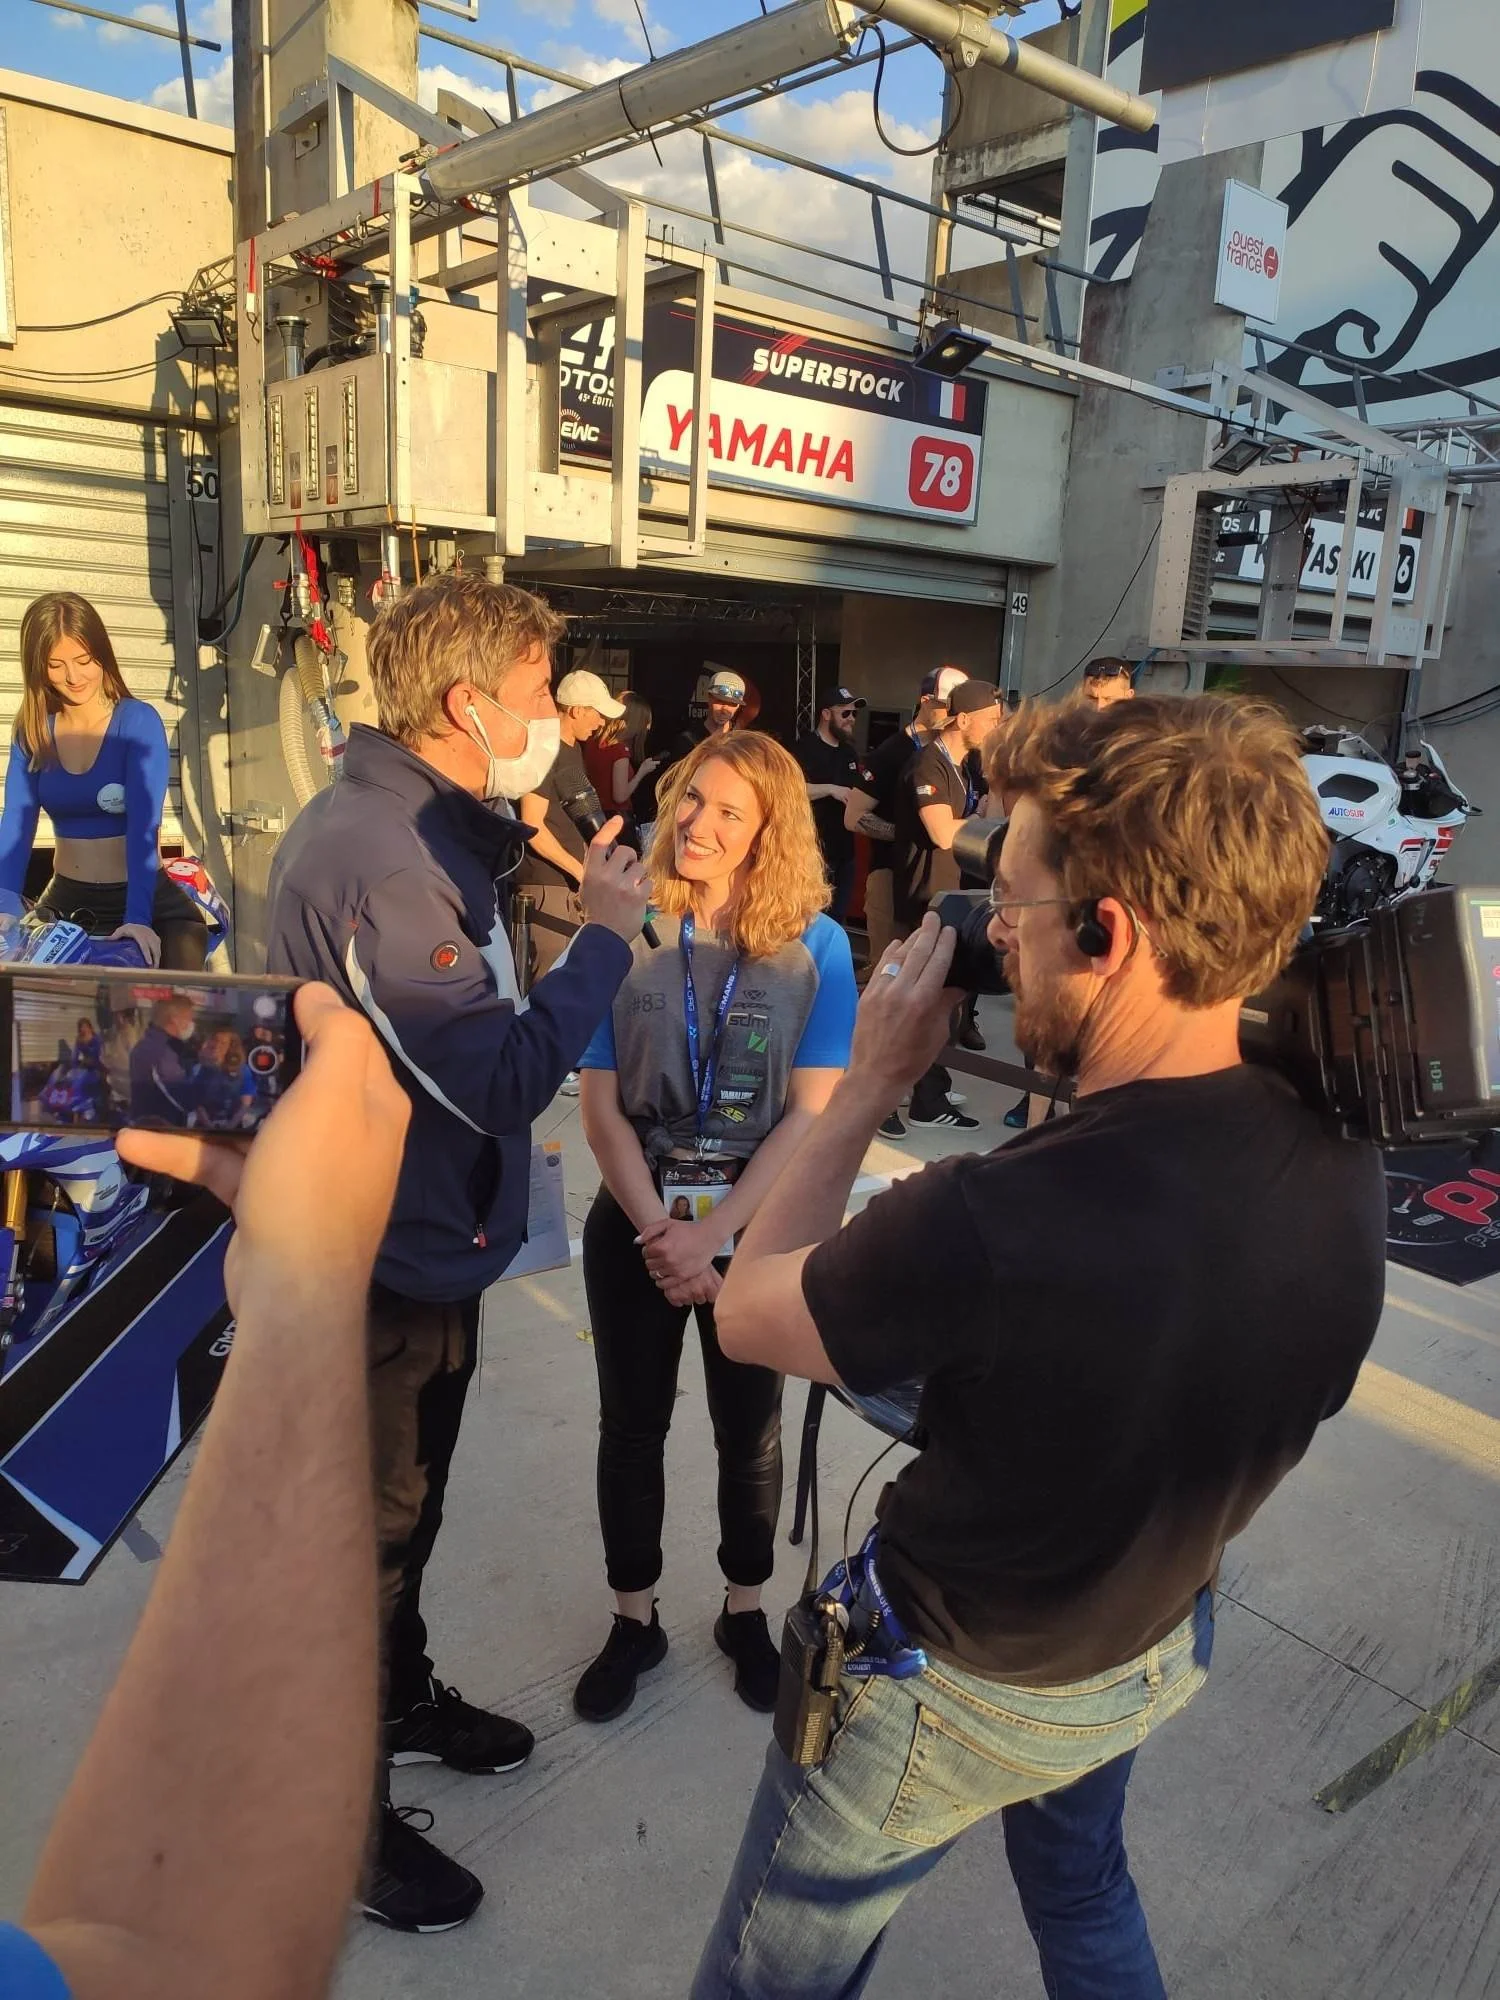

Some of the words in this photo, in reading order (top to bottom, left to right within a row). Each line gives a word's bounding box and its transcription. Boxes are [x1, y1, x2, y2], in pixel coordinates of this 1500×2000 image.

[1227, 240, 1262, 273] france
[1233, 231, 1264, 257] ouest
[752, 348, 905, 402] SUPERSTOCK
[560, 421, 600, 442] EWC
[666, 404, 855, 482] YAMAHA
[186, 470, 220, 500] 50
[919, 451, 964, 497] 78
[1012, 596, 1027, 614] 49
[1328, 807, 1365, 818] AUTOSUR
[631, 992, 666, 1016] #83
